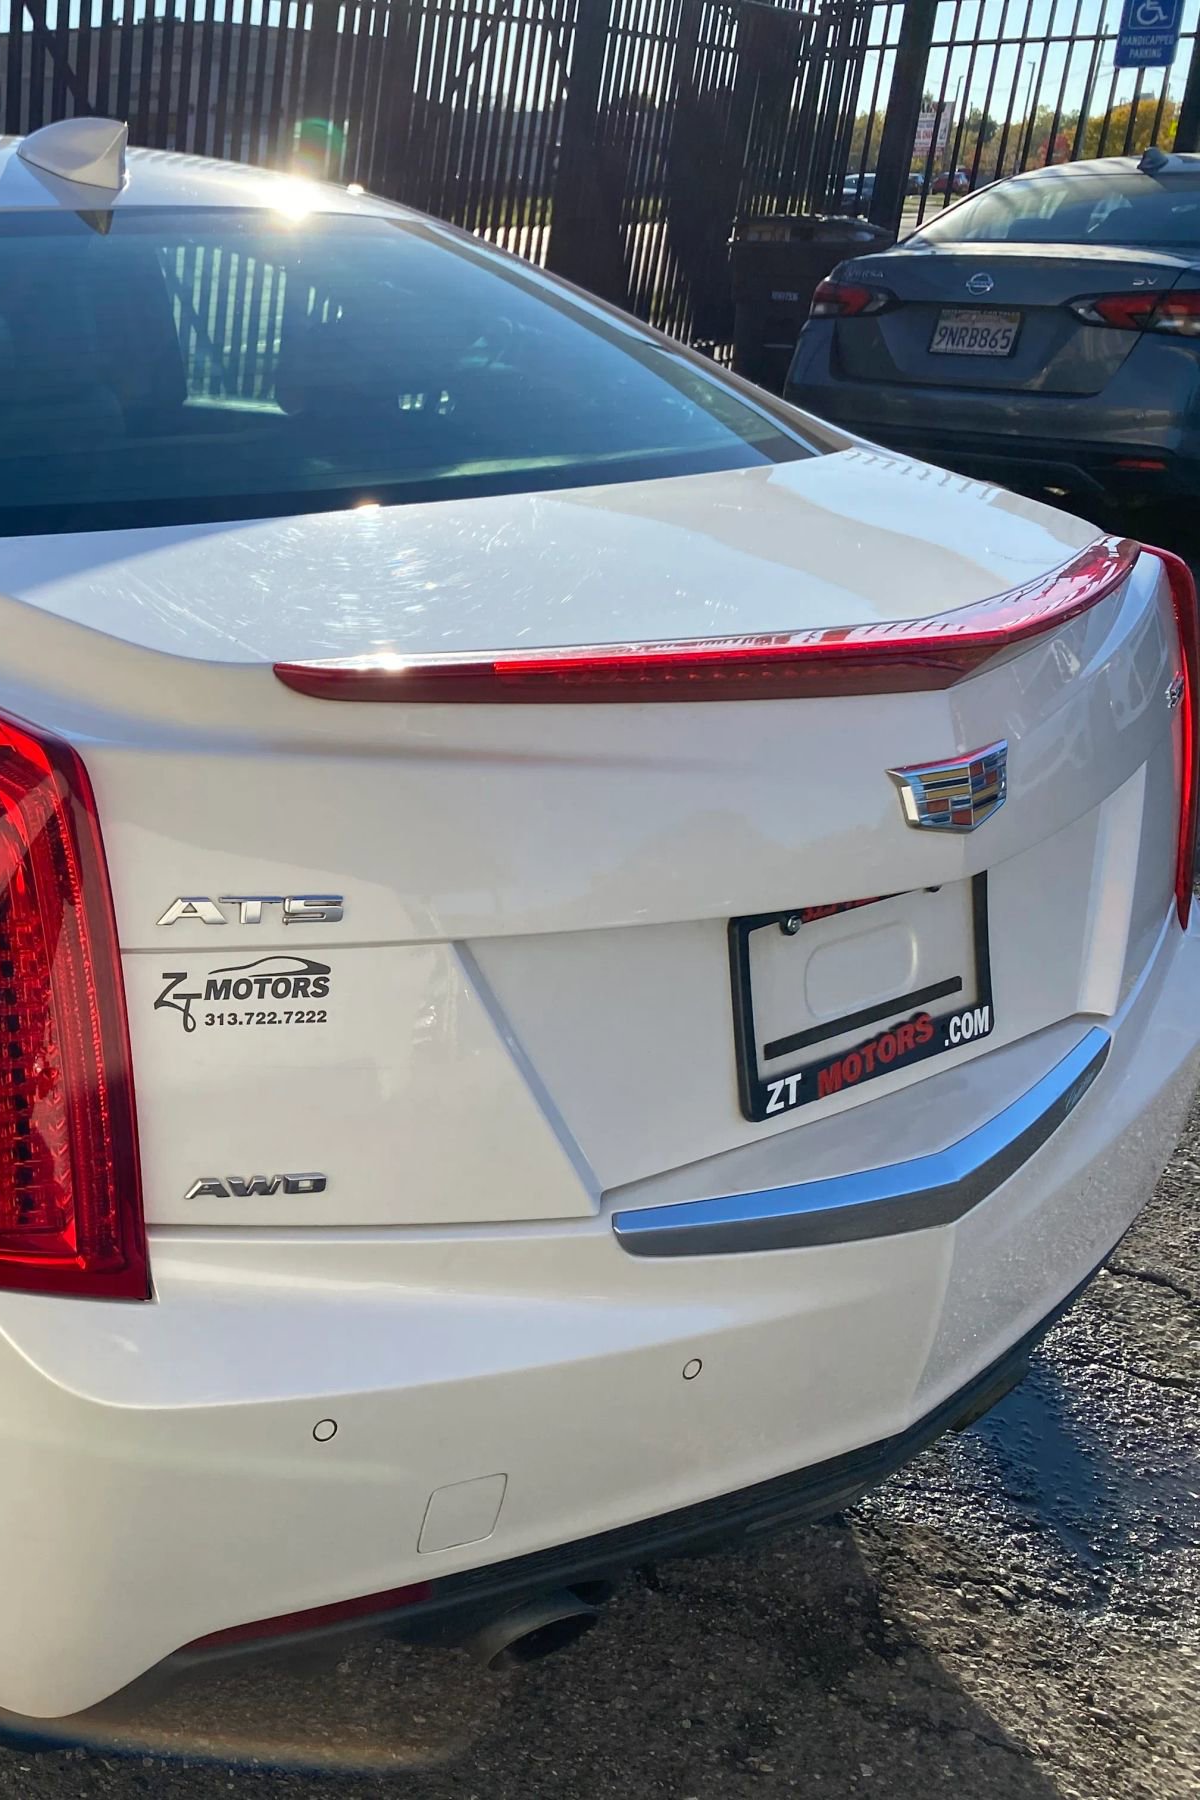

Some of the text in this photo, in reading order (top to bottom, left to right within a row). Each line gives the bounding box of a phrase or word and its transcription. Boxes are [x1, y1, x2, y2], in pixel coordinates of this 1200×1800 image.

[1121, 34, 1175, 46] HANDICAPPED
[1128, 48, 1162, 59] PARKING
[935, 326, 1013, 350] 9NRB865
[155, 895, 344, 925] ATS
[203, 976, 330, 1001] MOTORS
[204, 1010, 328, 1026] 313.722.7222
[765, 1005, 990, 1114] ZT MOTORS .COM
[183, 1172, 328, 1200] AWD
